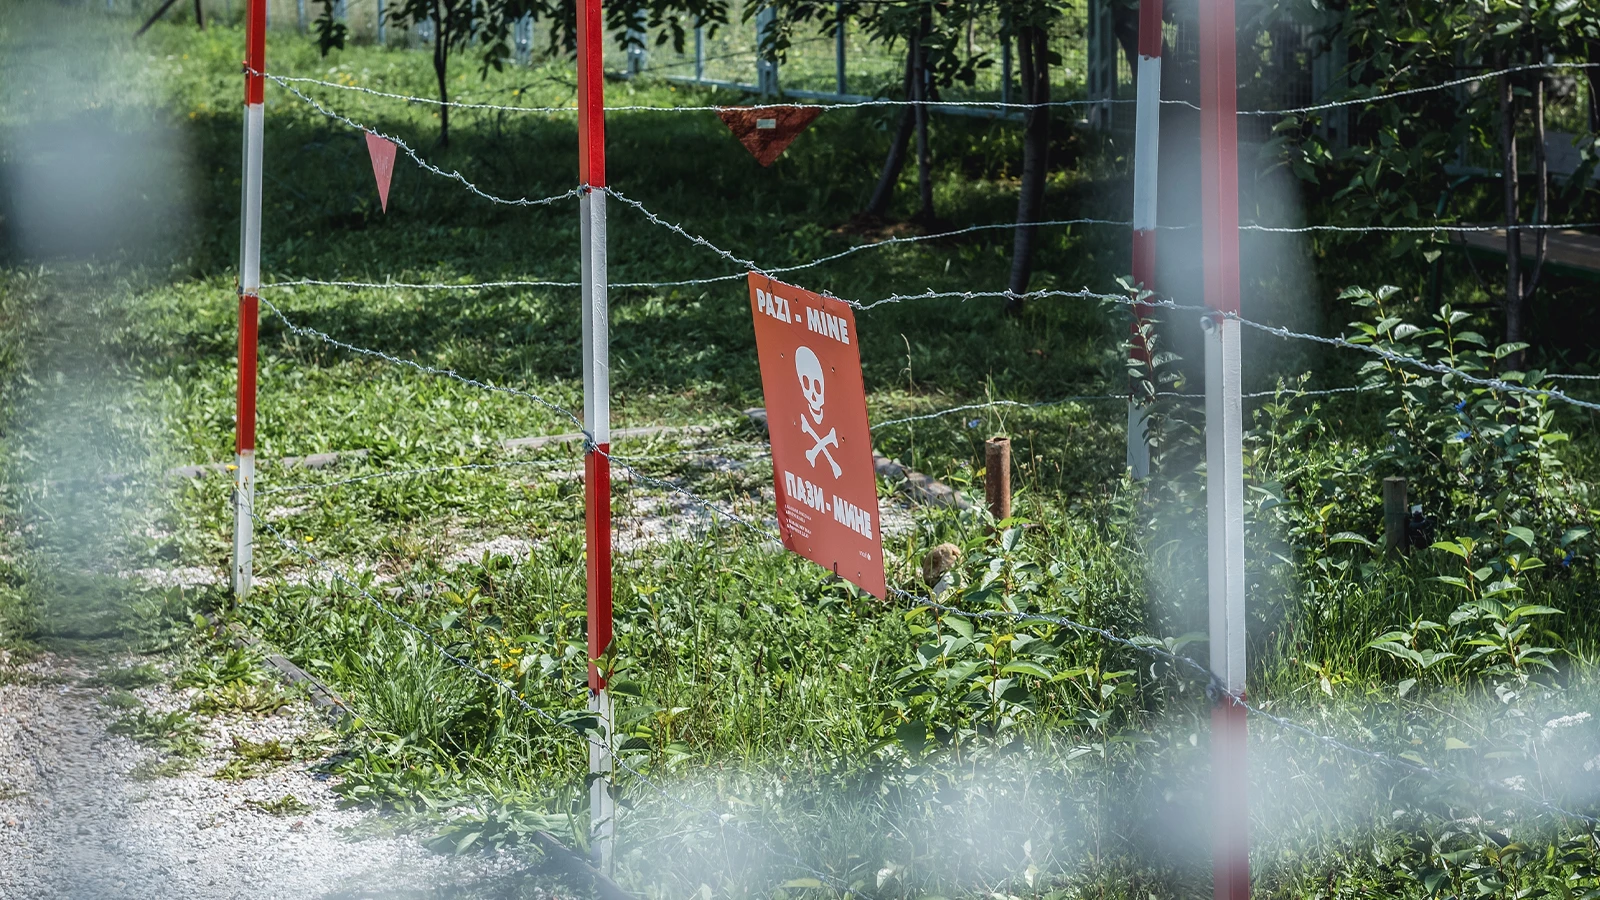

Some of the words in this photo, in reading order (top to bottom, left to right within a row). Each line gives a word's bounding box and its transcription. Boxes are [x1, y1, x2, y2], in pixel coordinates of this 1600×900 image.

[756, 288, 791, 324] PAZI
[806, 306, 850, 345] MINE
[785, 470, 825, 514] ПАЗИ
[833, 494, 873, 540] МИНЕ
